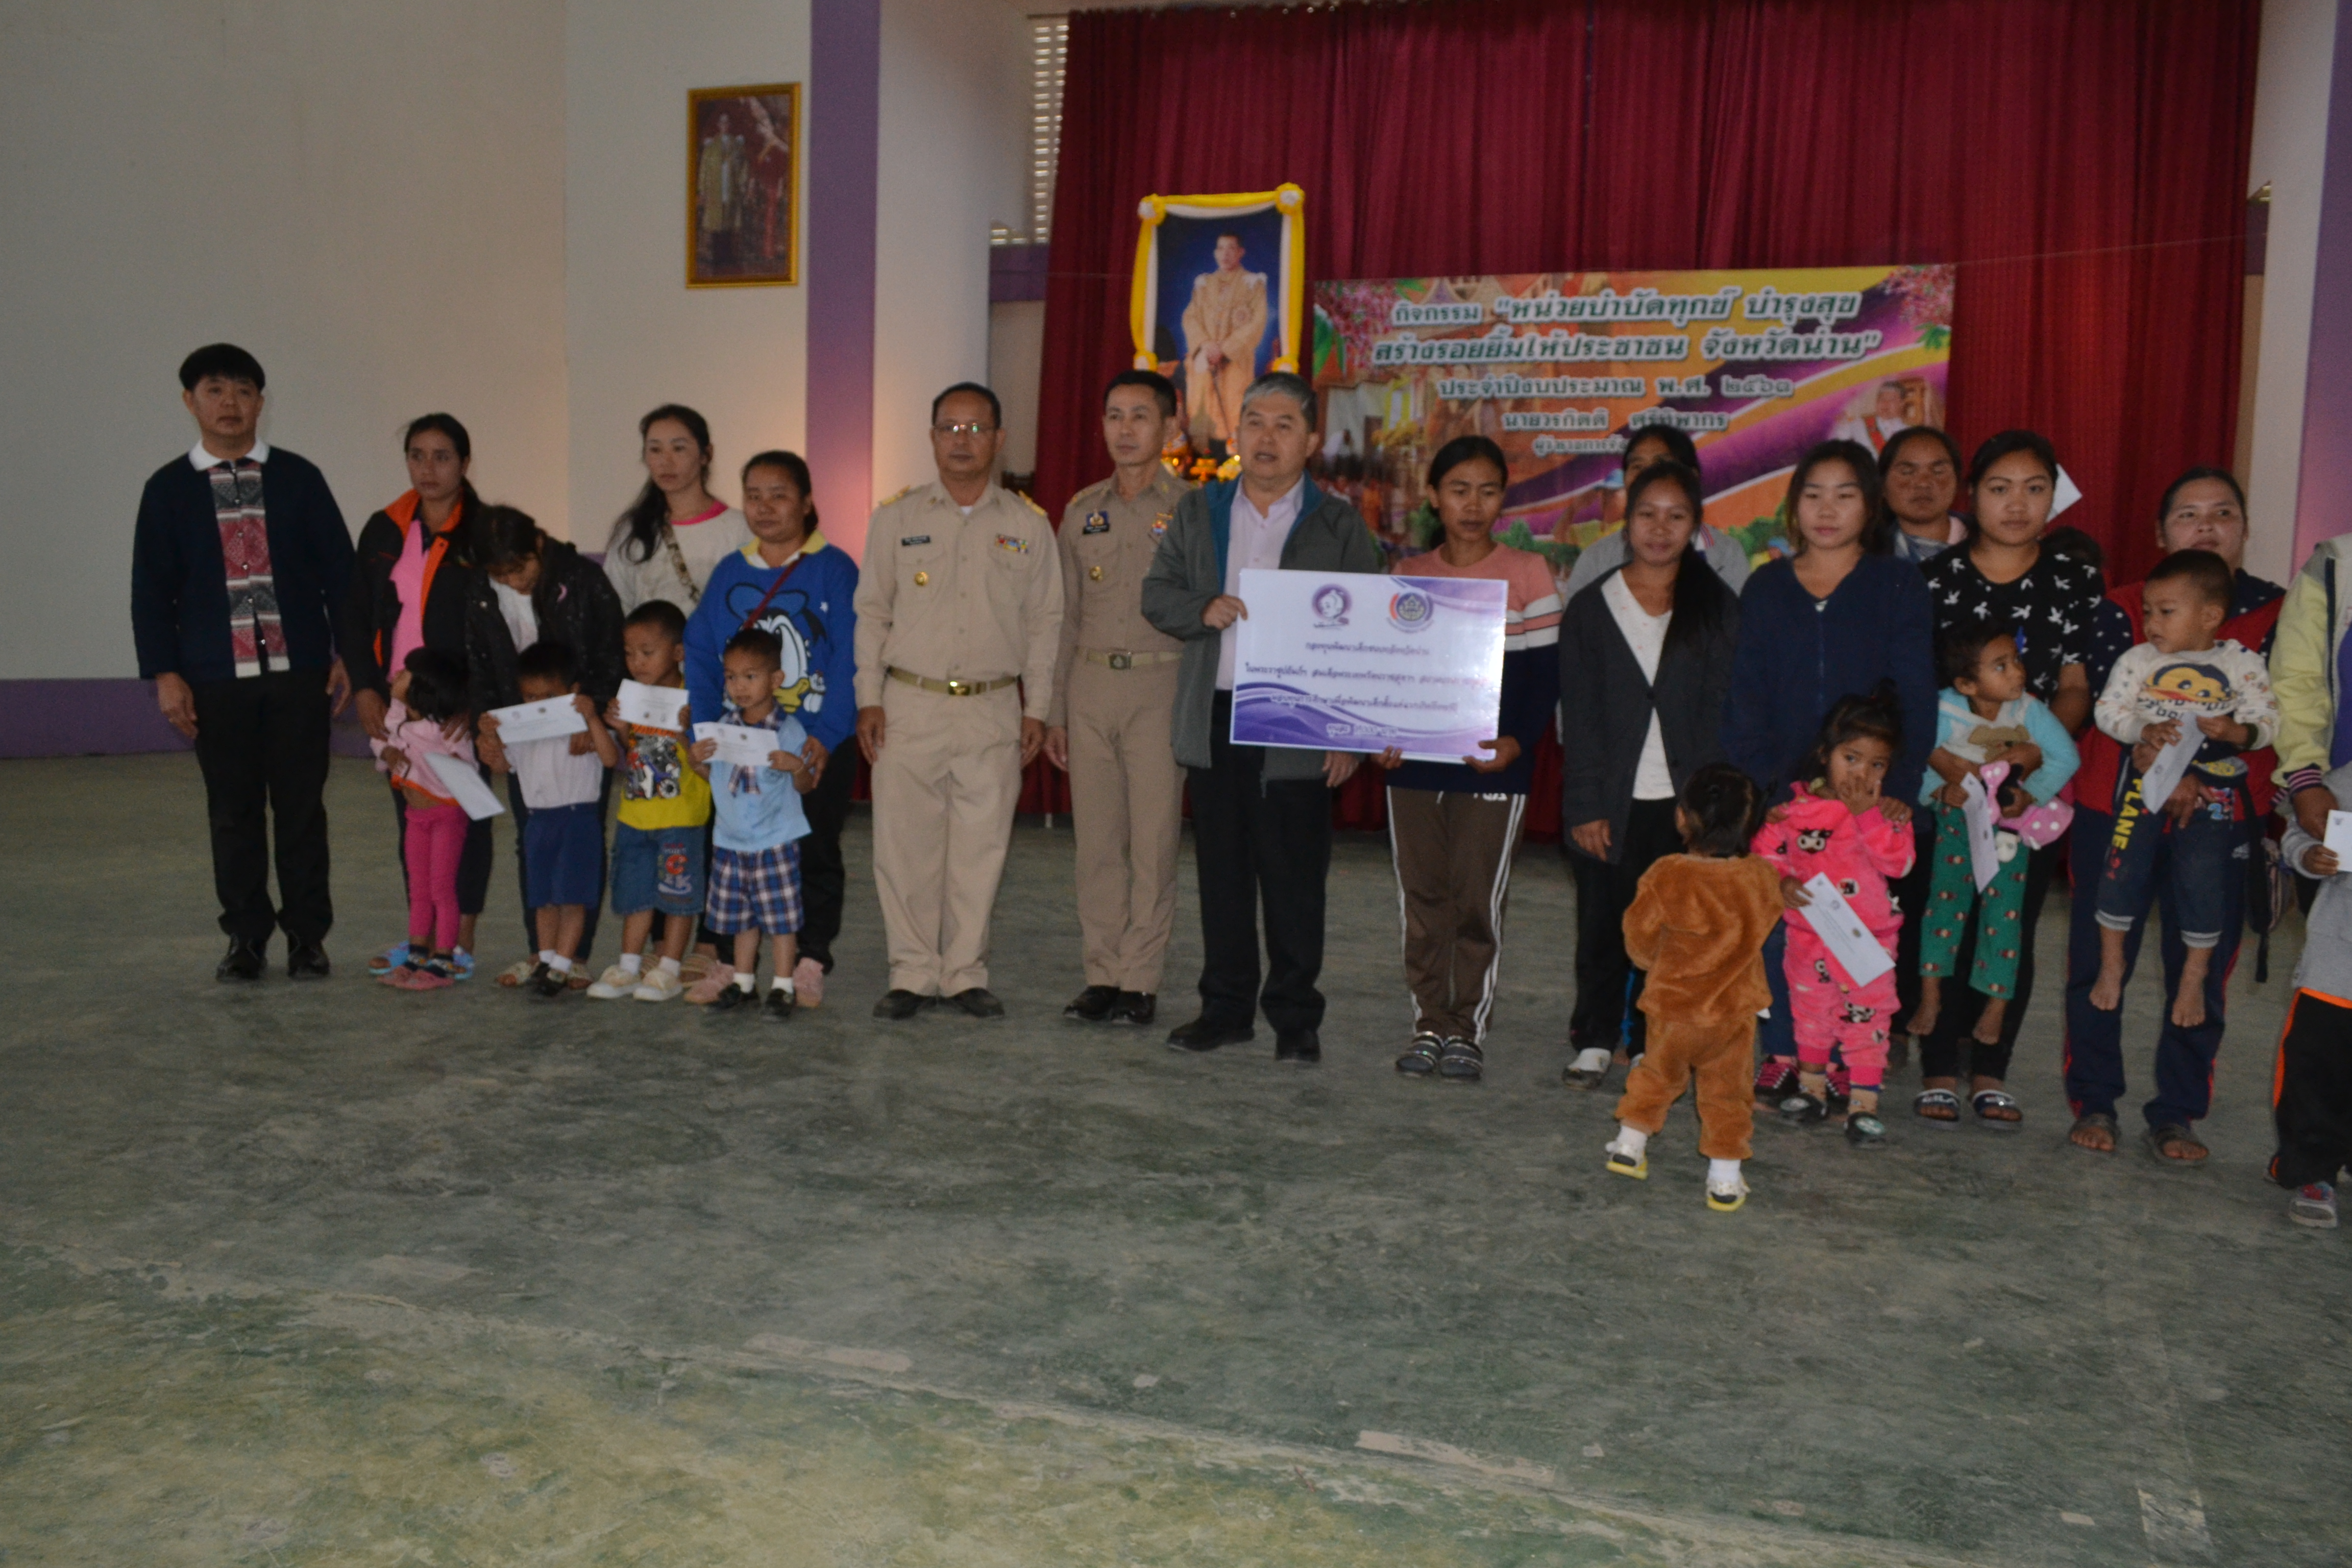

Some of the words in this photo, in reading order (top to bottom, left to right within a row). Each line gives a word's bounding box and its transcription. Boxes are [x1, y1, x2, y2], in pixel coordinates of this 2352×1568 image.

[1394, 300, 1480, 324] กิจกรรม
[1746, 287, 1861, 325] บำรุงสุข
[1375, 326, 1687, 363] สร้างรอยยิ้มให้ประชาชน
[1439, 373, 1644, 398] ประจำปีงบประมาณ
[1657, 375, 1710, 396] พ.ศ.
